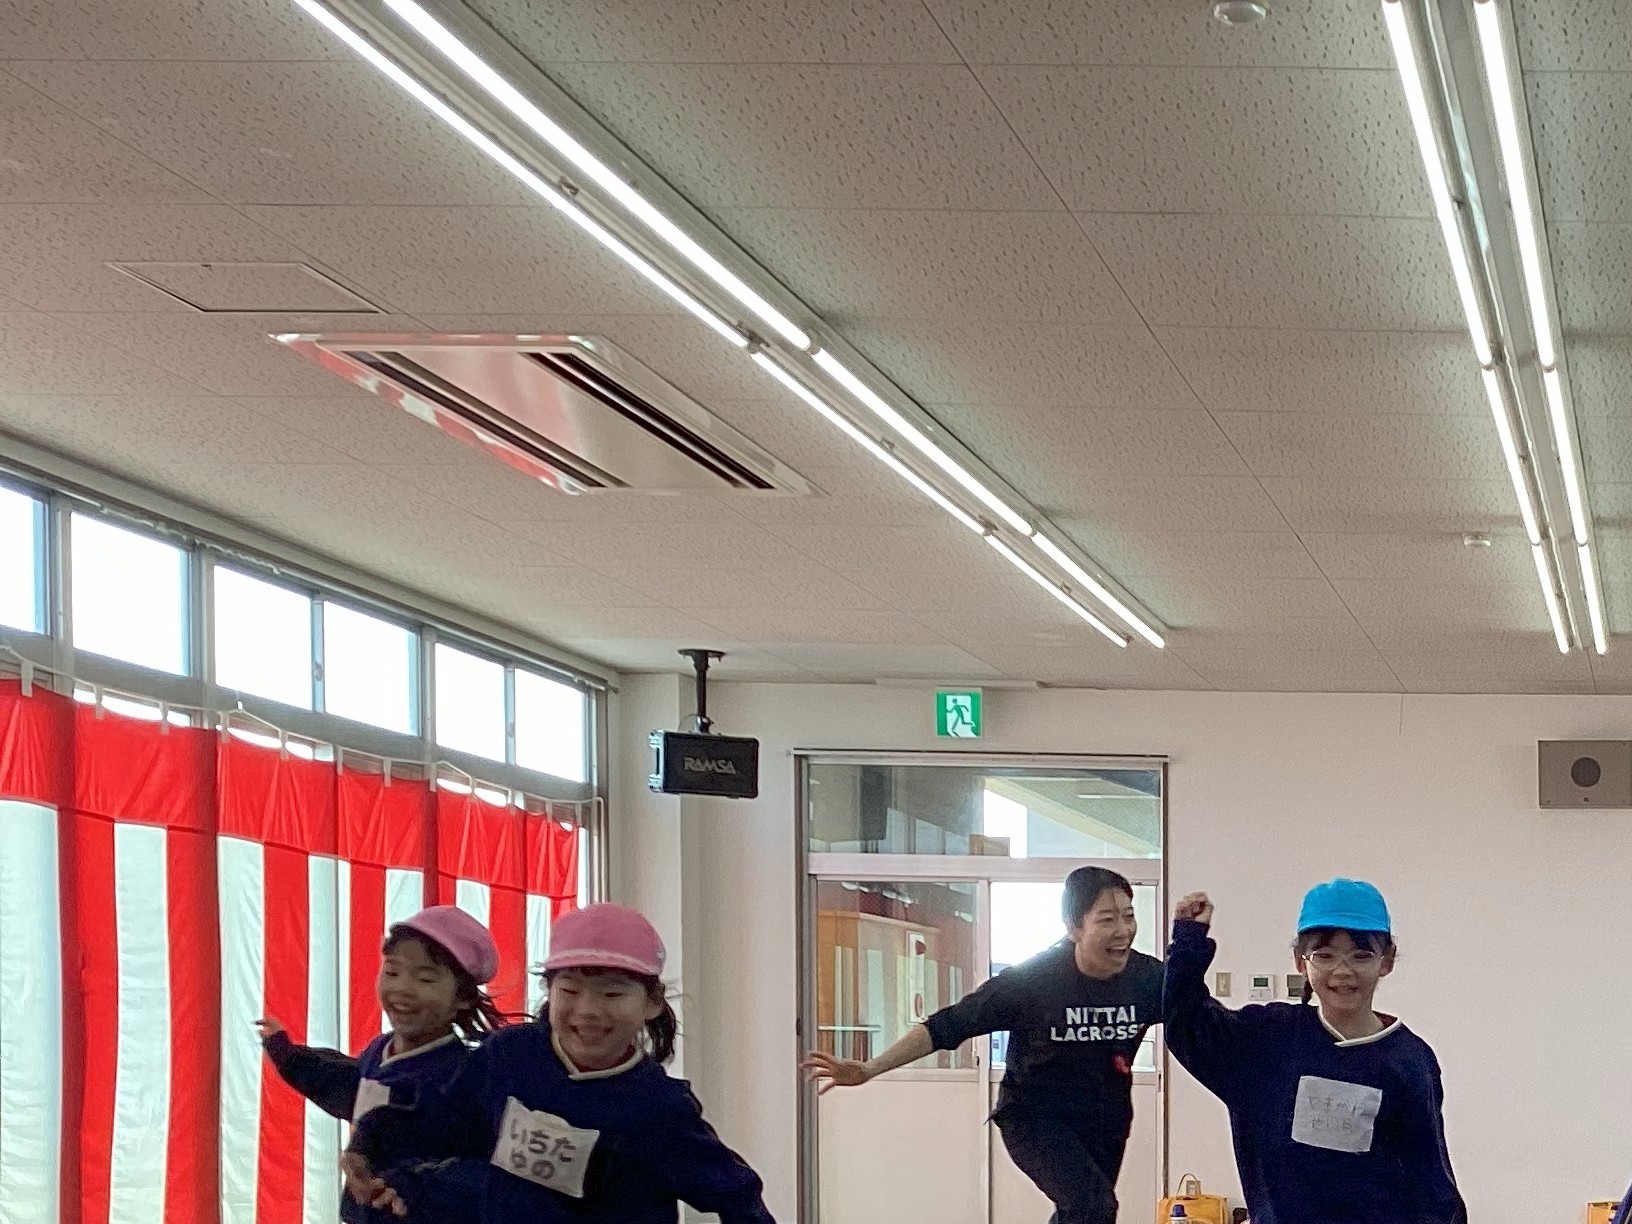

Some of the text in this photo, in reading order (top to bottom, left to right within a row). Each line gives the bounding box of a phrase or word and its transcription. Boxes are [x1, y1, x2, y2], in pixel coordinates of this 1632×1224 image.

[683, 756, 737, 775] RAMSA
[1066, 1005, 1136, 1025] NITTAI
[1050, 1023, 1145, 1042] LACROSS
